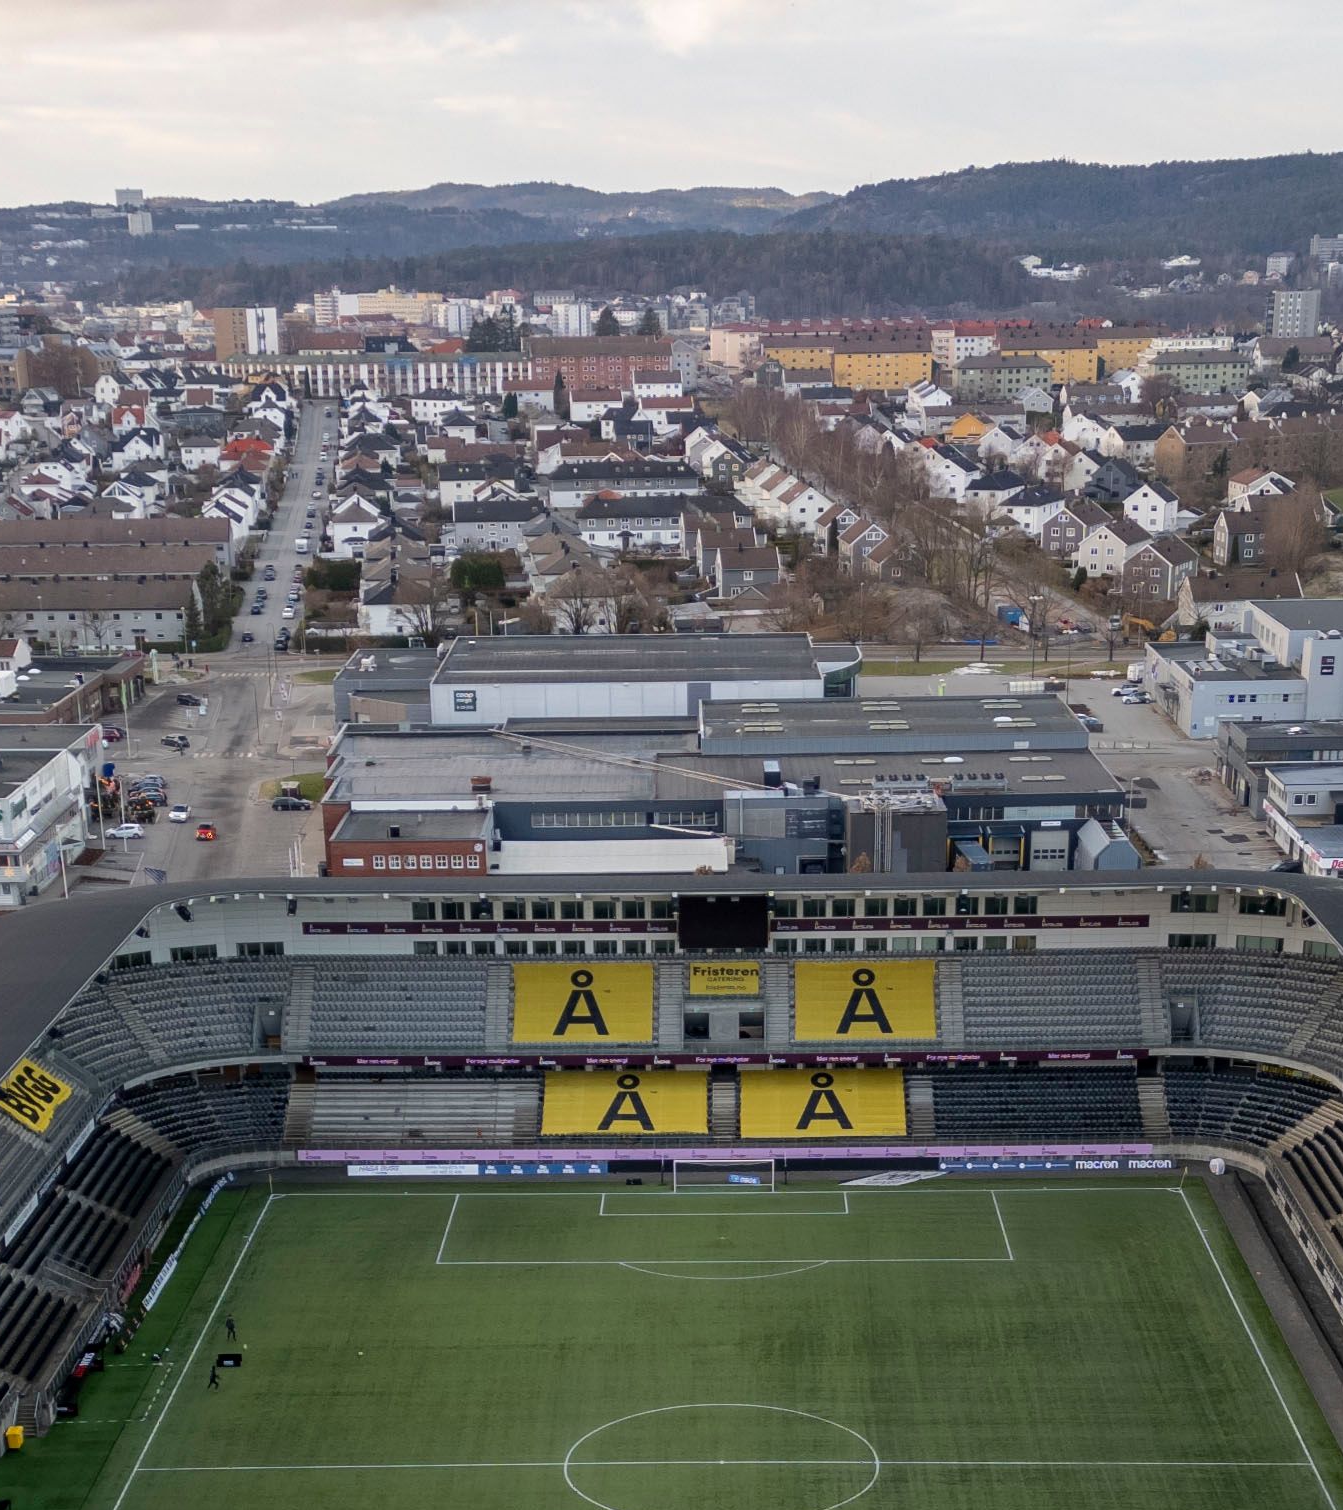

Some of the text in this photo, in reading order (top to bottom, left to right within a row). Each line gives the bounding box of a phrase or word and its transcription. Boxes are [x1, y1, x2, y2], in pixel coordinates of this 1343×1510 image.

[692, 966, 759, 977] Fristeren
[553, 969, 610, 1036] Å
[836, 968, 894, 1034] Å
[5, 1065, 61, 1124] BYGG
[597, 1074, 655, 1131] Å
[795, 1072, 853, 1130] Å
[1075, 1160, 1119, 1169] macron
[1128, 1159, 1172, 1169] macron
